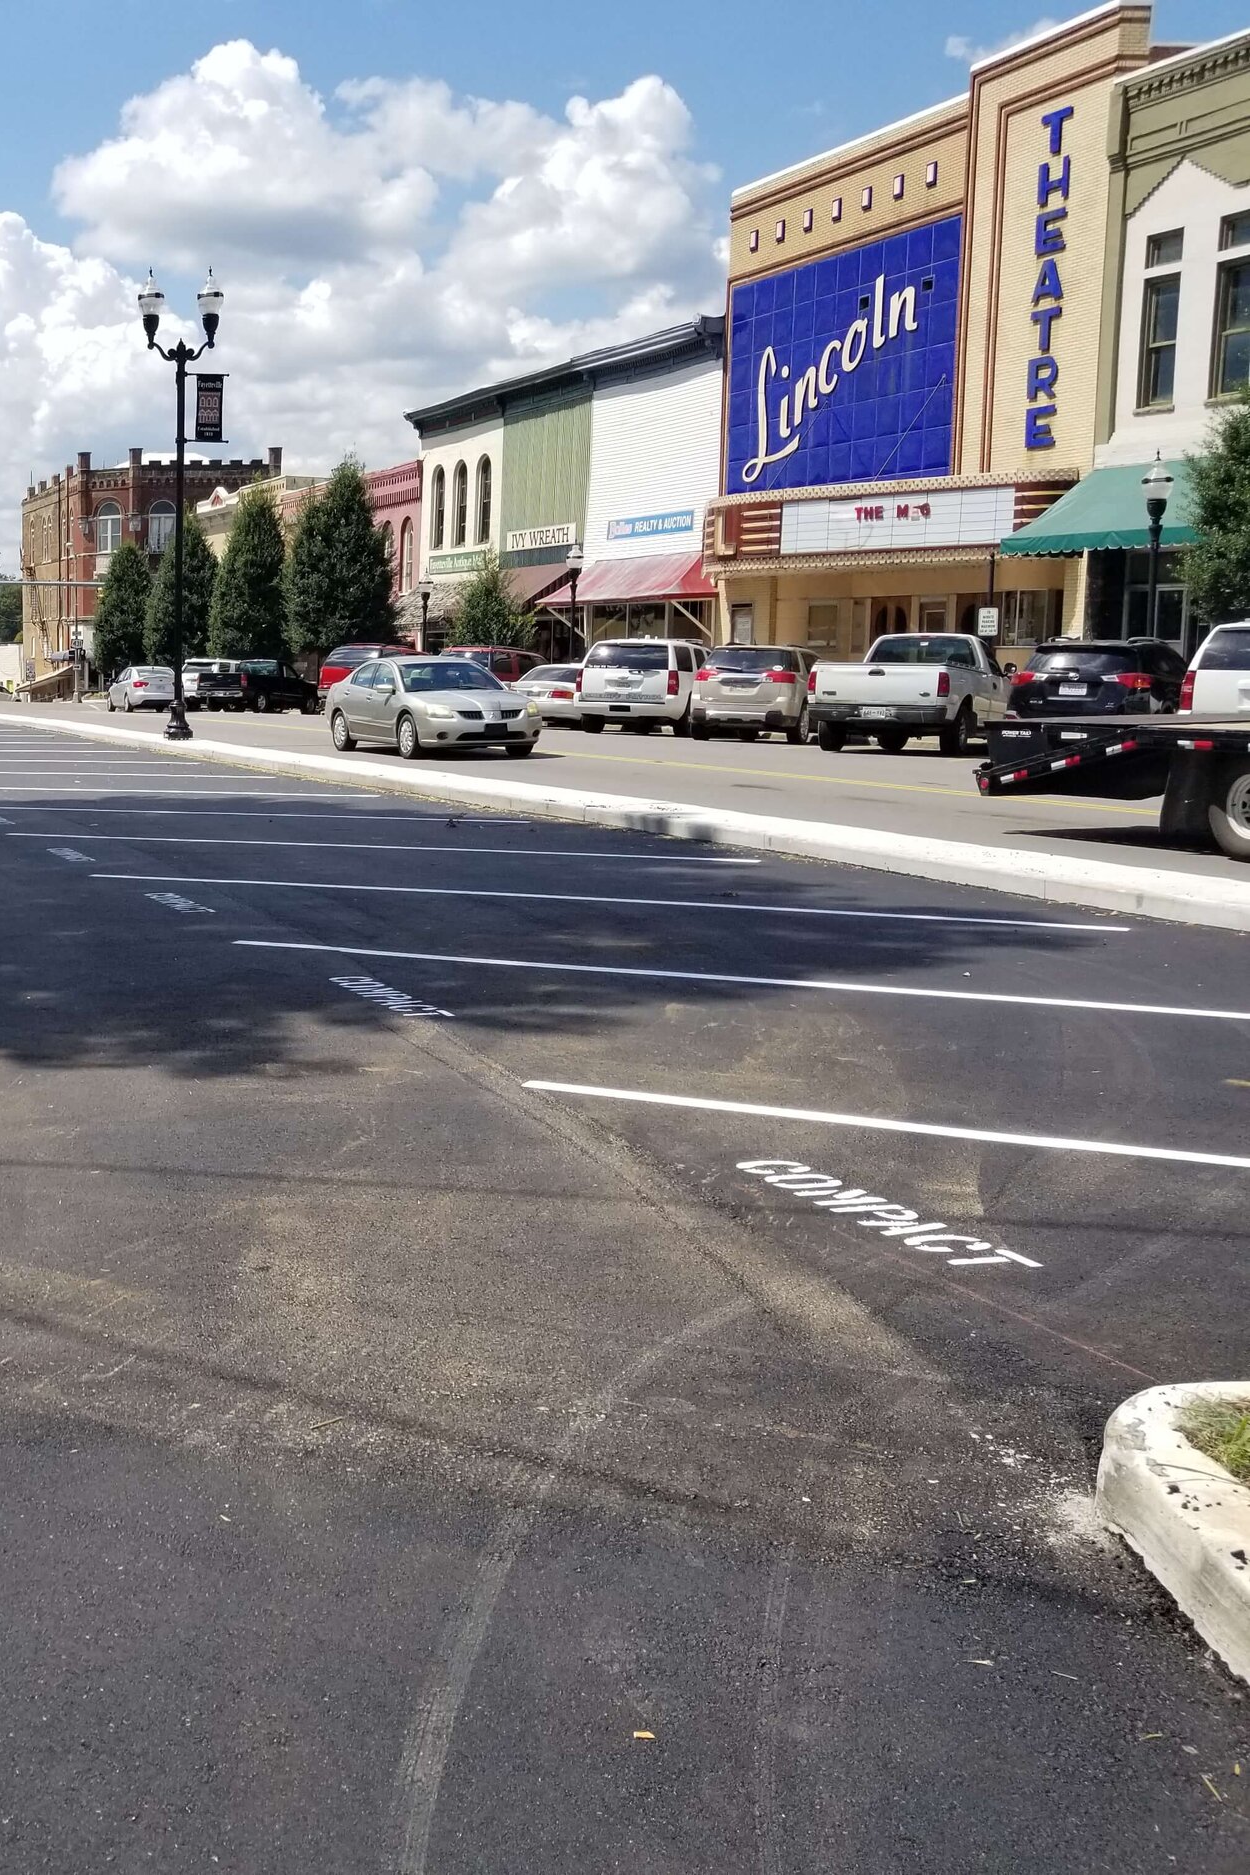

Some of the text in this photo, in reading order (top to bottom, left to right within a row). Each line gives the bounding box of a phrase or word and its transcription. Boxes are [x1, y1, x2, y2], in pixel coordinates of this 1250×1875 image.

[1024, 105, 1074, 450] THEATRE
[742, 273, 918, 483] Lincoln
[634, 519, 657, 532] REALTY
[658, 518, 663, 530] &
[663, 515, 692, 529] AUCTION
[854, 503, 931, 521] THE MG
[511, 526, 570, 549] IVY WREATH
[472, 554, 485, 567] Ma
[328, 976, 456, 1017] COMPACT
[736, 1160, 1044, 1268] COMPACT
